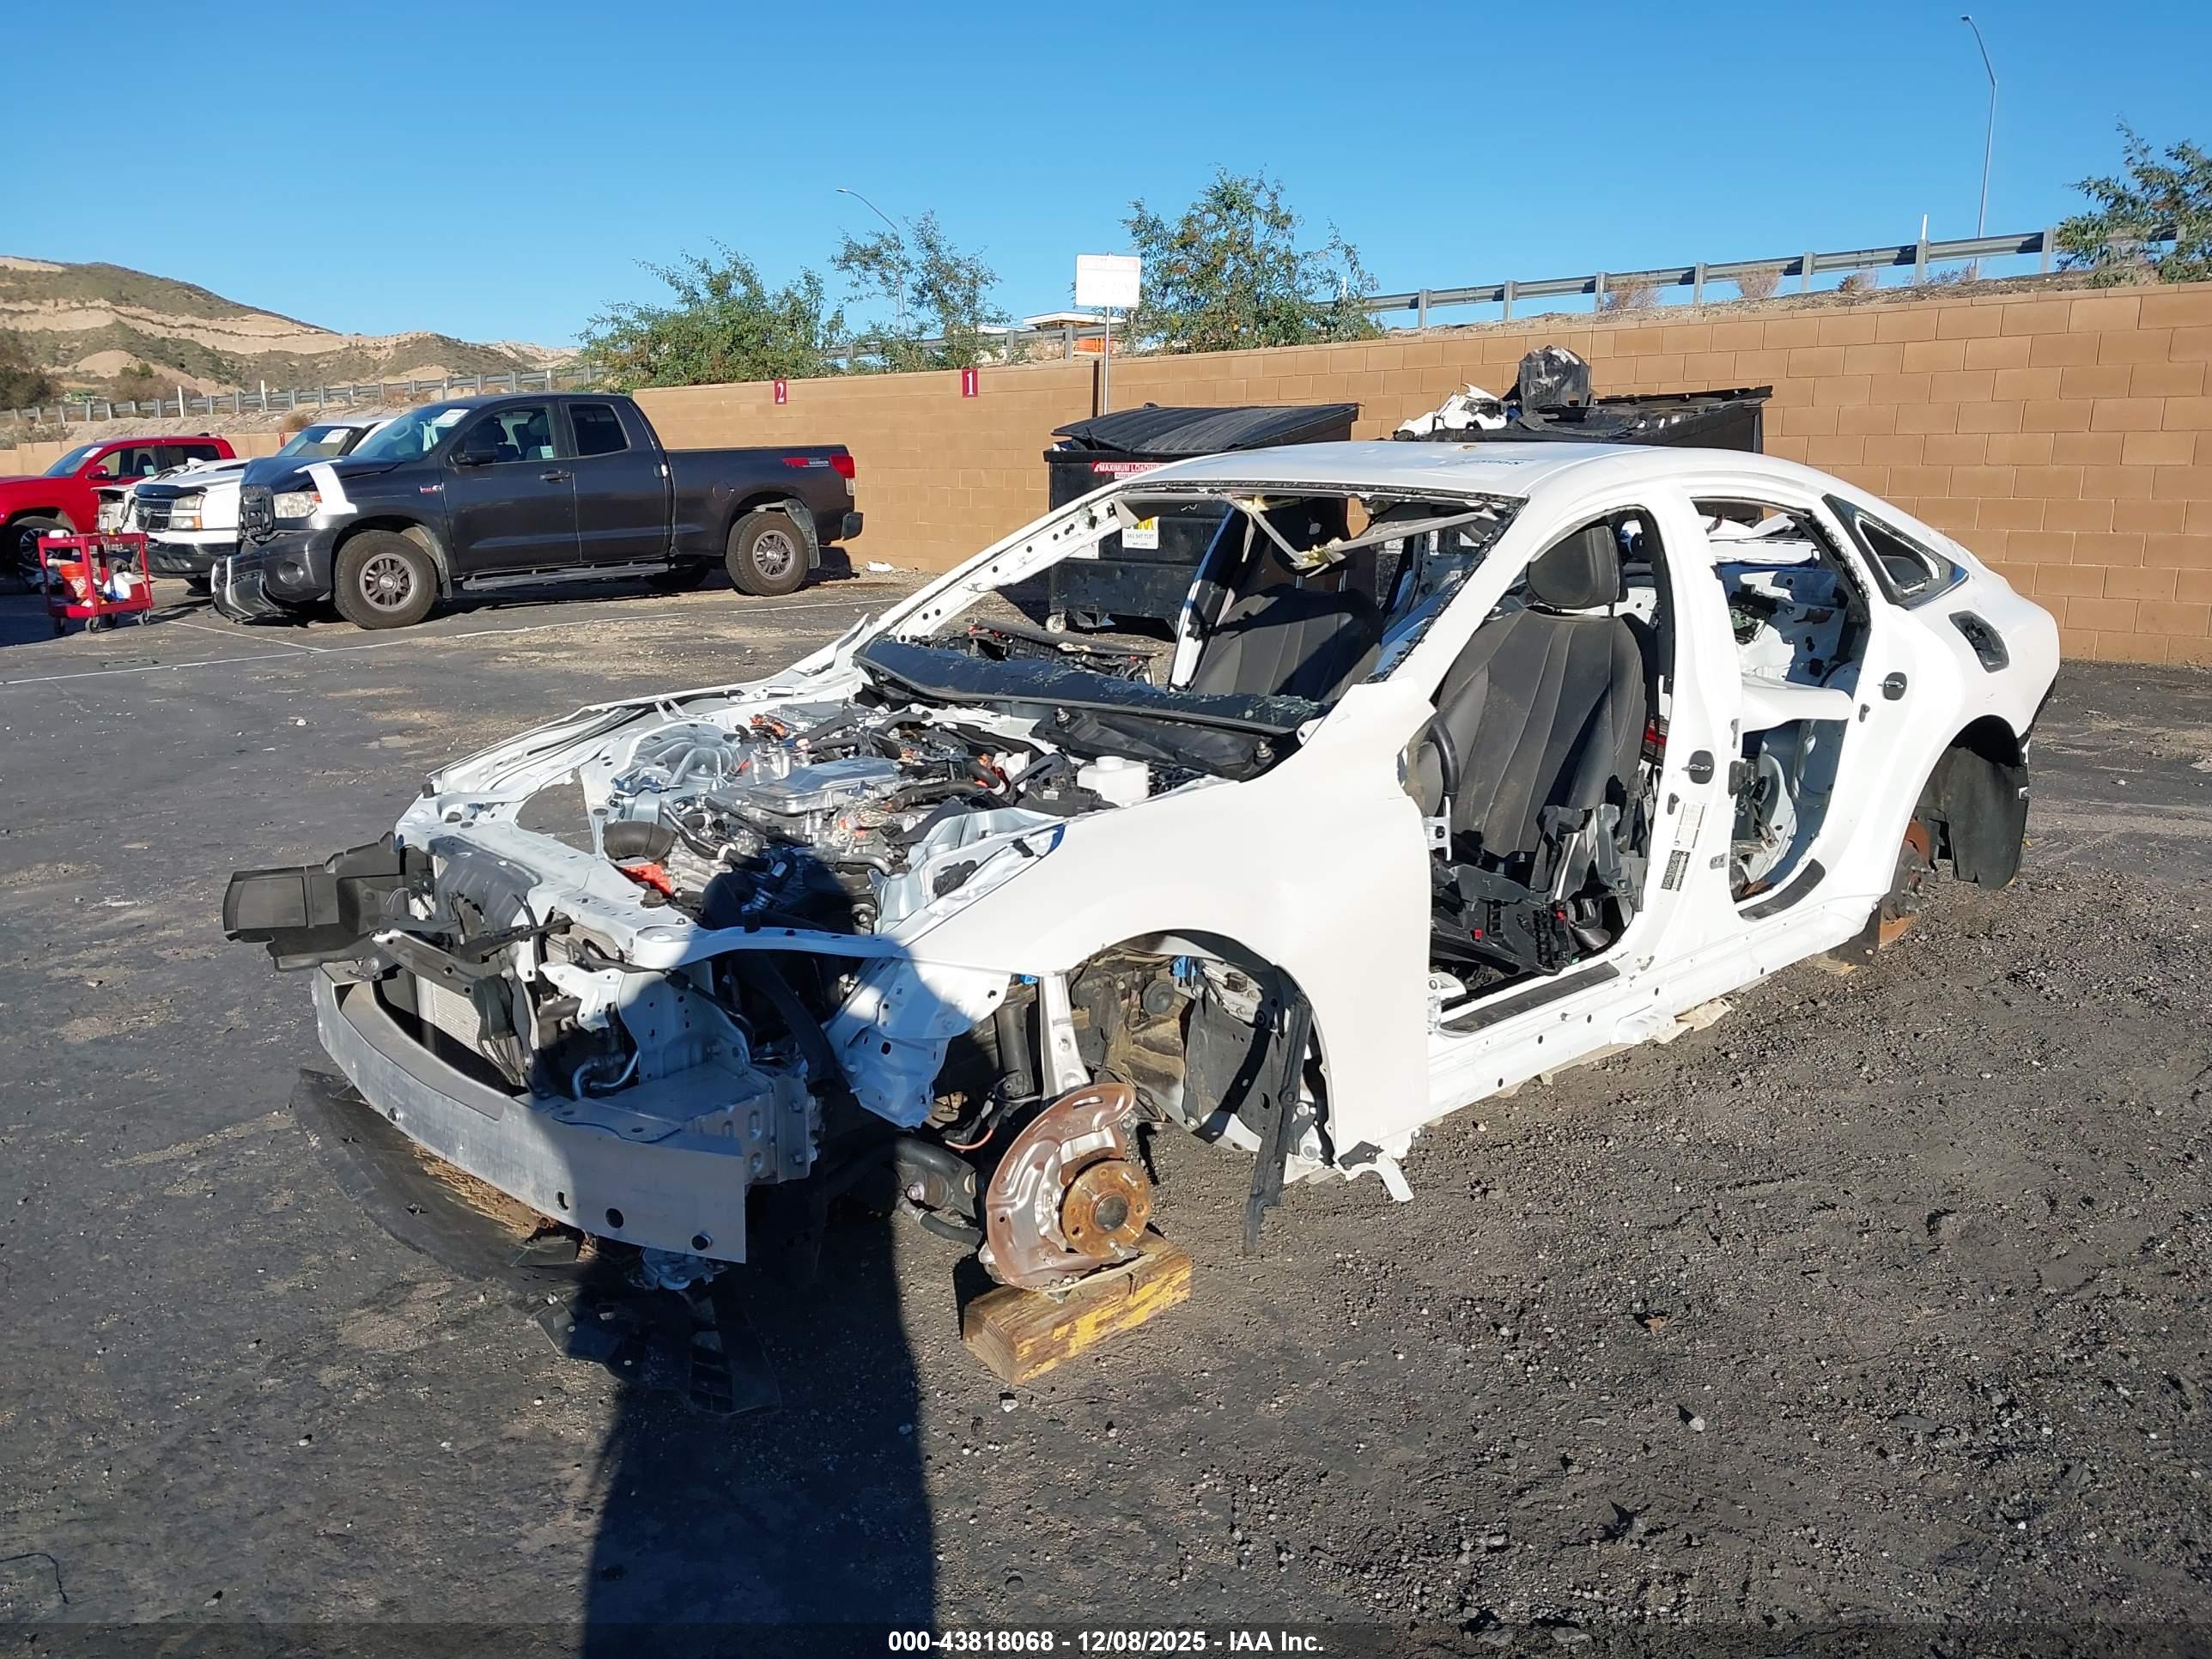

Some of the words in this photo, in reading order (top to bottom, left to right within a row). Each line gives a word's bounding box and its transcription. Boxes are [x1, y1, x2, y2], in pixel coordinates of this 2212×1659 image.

[777, 382, 785, 403] 2
[966, 371, 975, 395] 1
[1099, 464, 1130, 472] MAXIMUM
